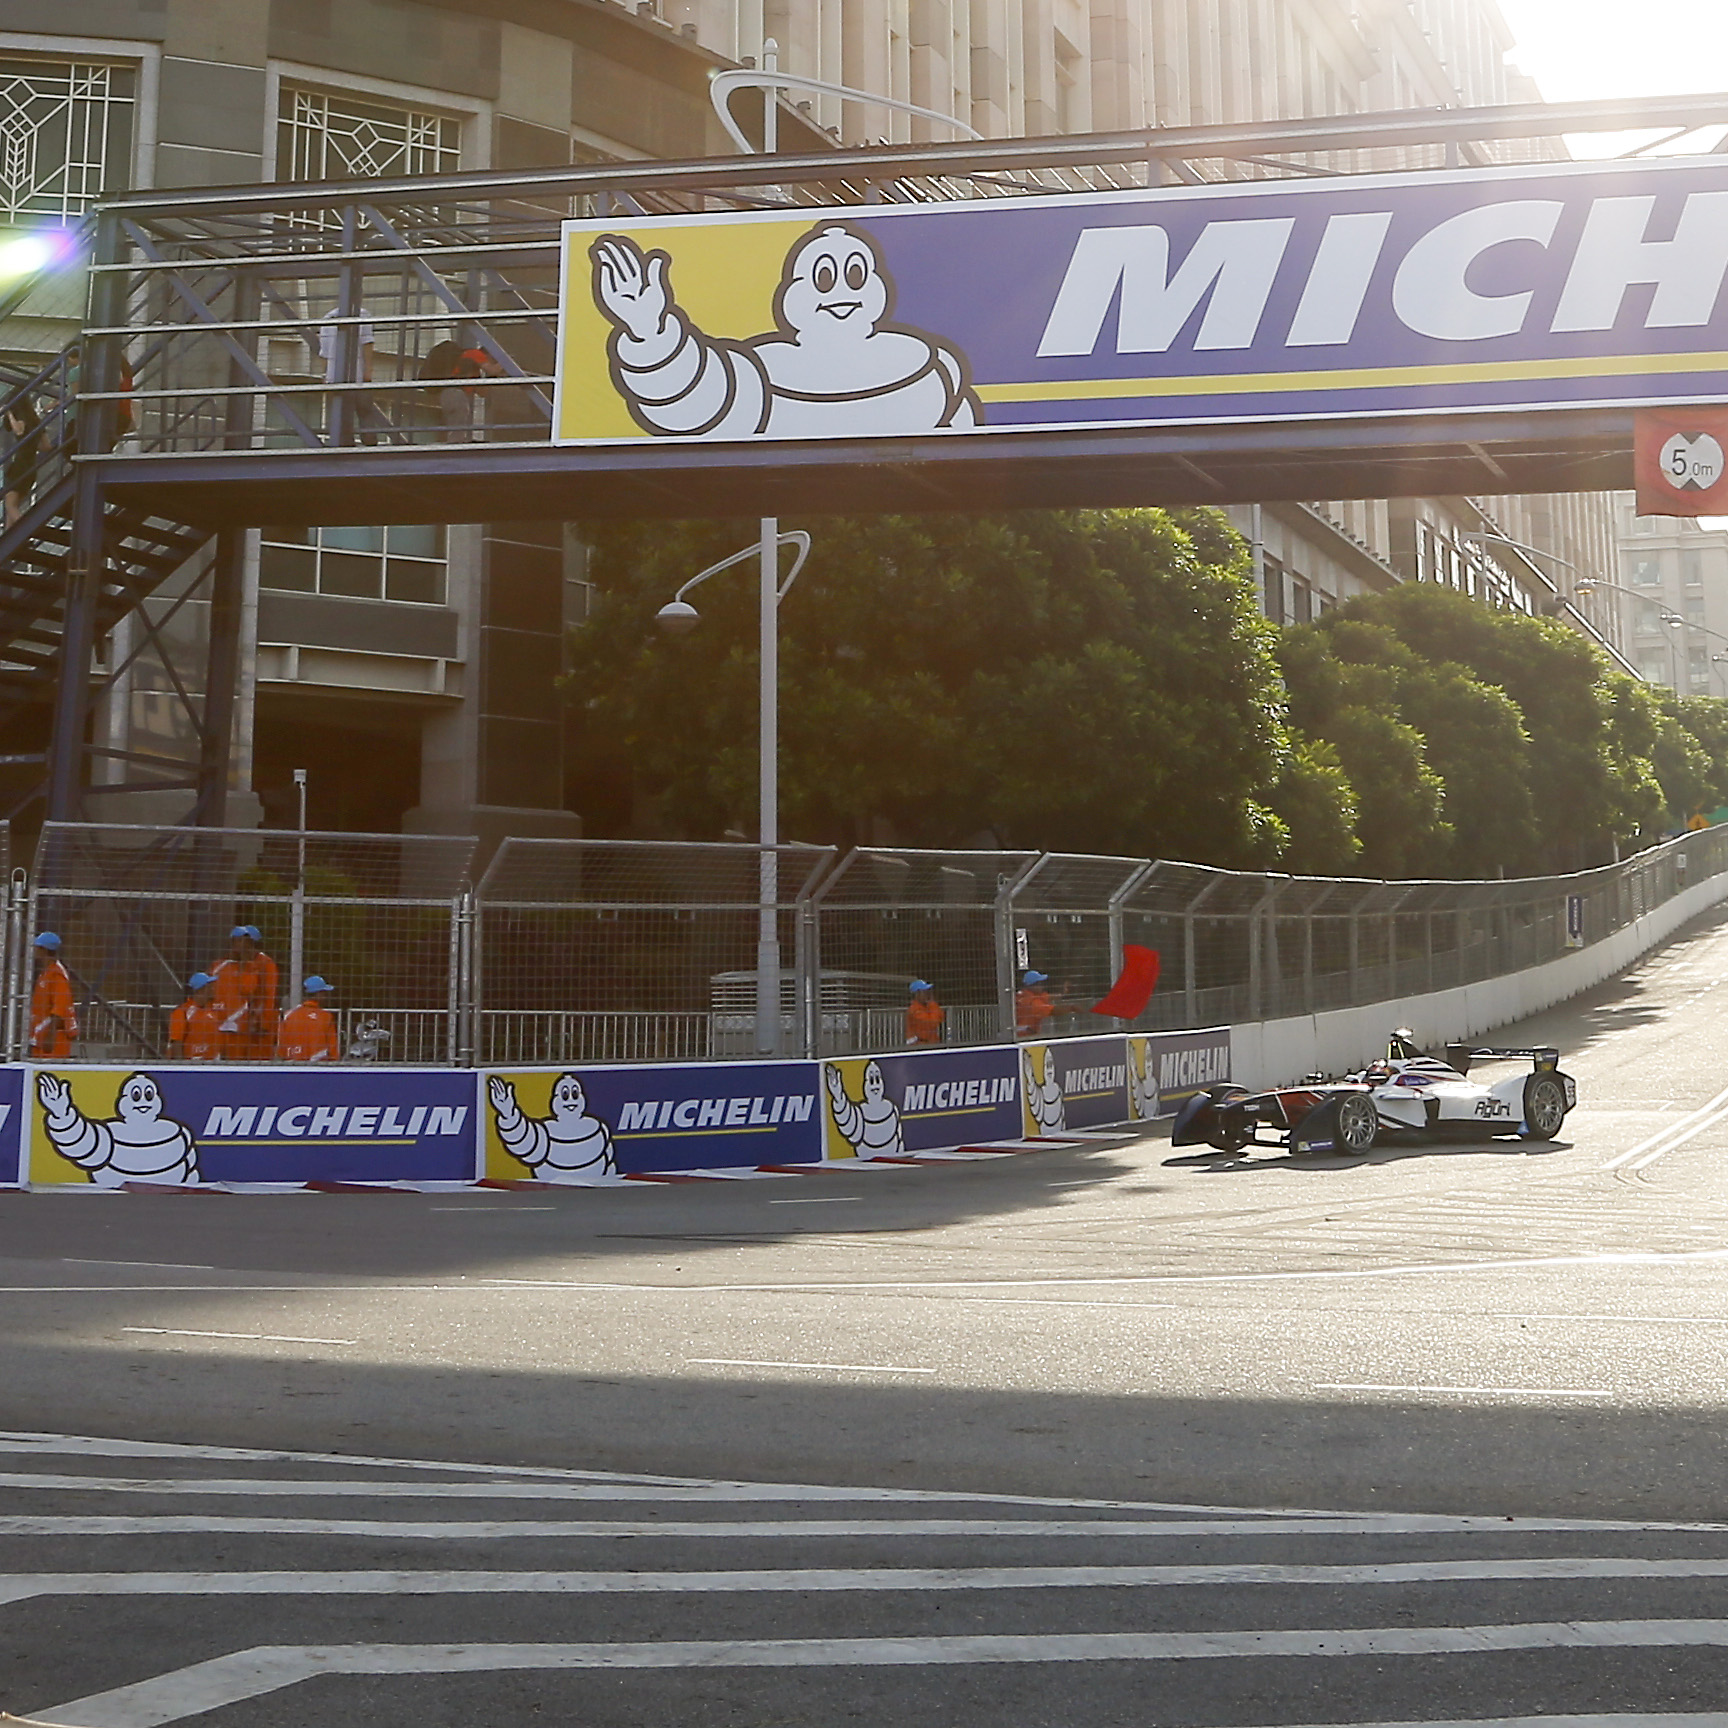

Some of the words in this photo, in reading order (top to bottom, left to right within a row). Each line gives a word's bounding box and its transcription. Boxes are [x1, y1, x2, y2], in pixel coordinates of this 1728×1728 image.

[1063, 1064, 1126, 1094] MICHELIN
[1158, 1045, 1230, 1090] MICHELIN
[903, 1076, 1016, 1112] MICHELIN
[202, 1105, 469, 1136] MICHELIN
[617, 1094, 815, 1131] MICHELIN
